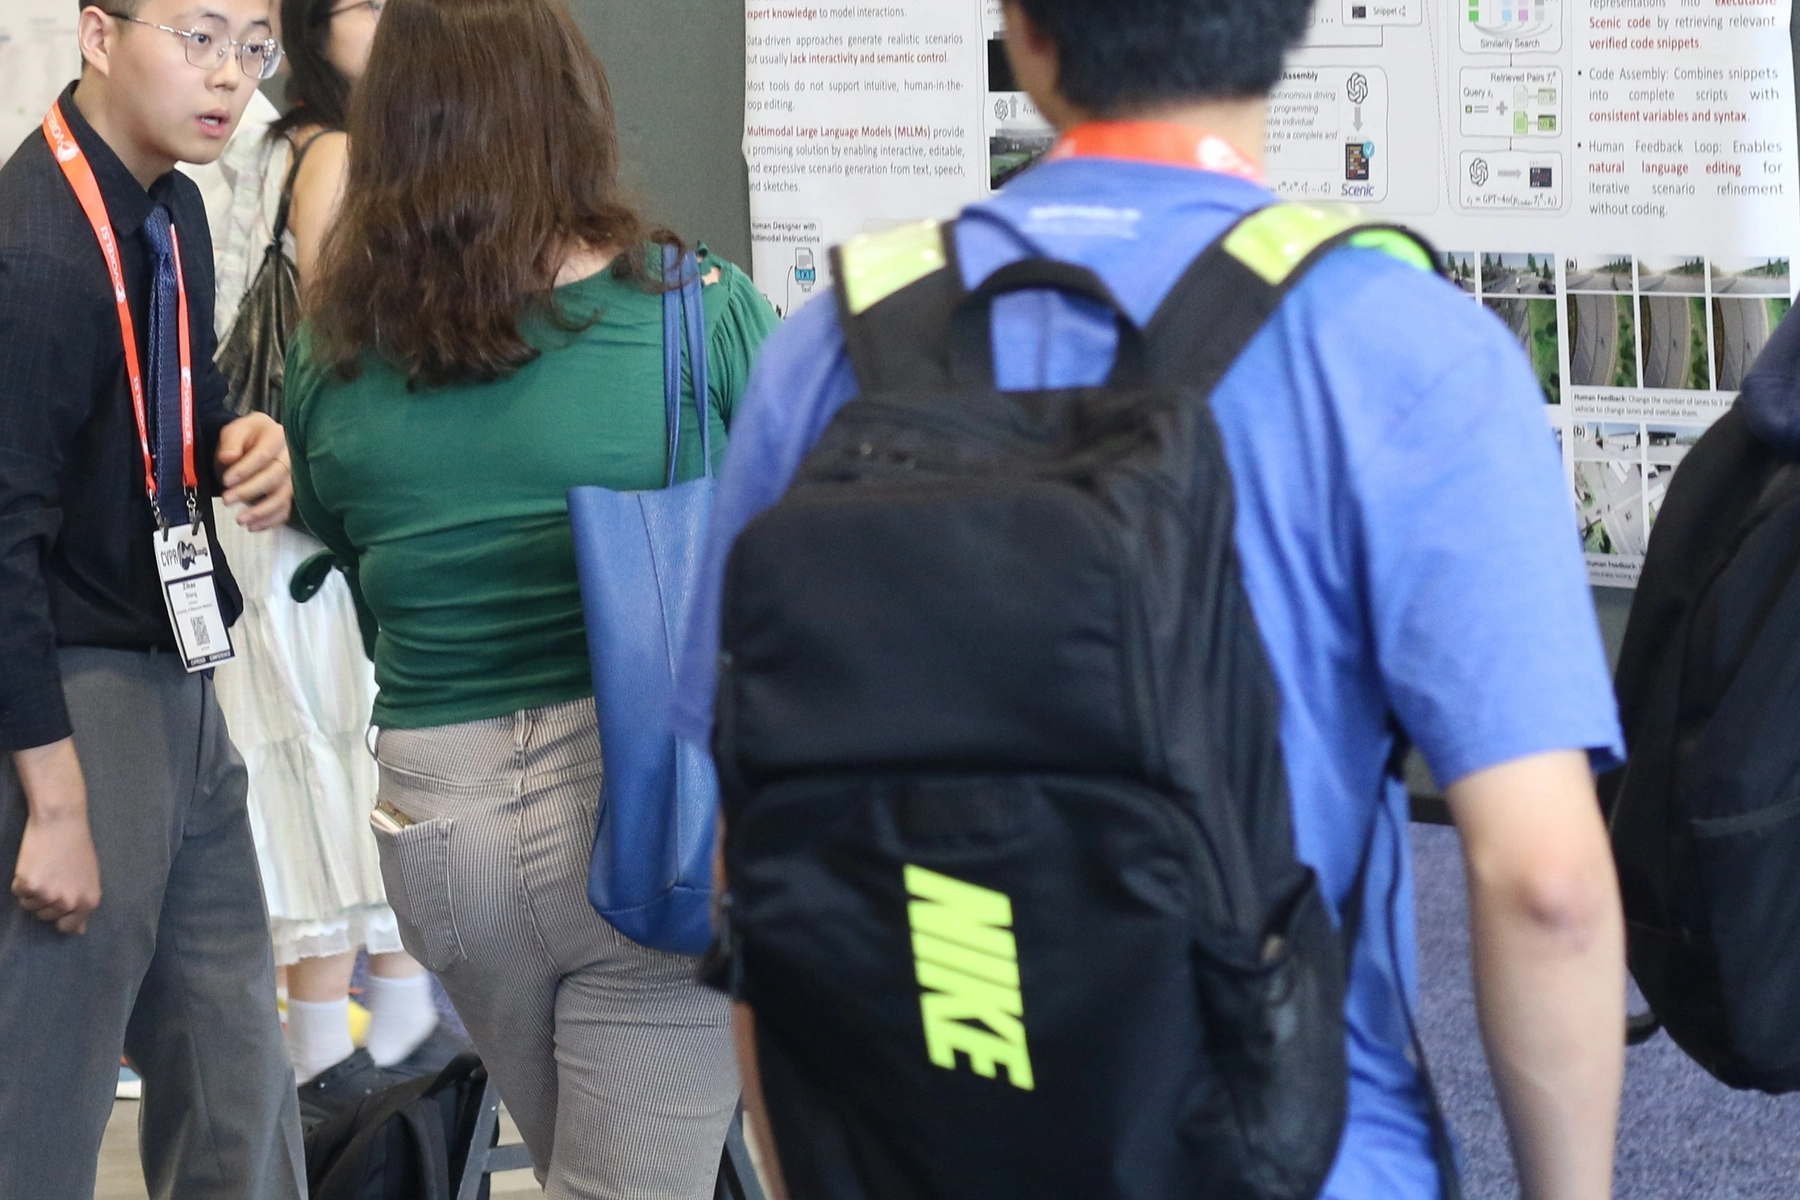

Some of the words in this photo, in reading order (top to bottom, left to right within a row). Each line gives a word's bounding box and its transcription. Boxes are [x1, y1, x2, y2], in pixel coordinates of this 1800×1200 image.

[772, 4, 817, 20] knowledge
[830, 3, 855, 18] model
[1590, 17, 1620, 29] Scenic
[1628, 16, 1651, 28] code
[1658, 16, 1668, 29] by
[1675, 15, 1722, 29] retrieving
[1729, 15, 1775, 27] relevant
[796, 34, 843, 48] approaches
[848, 35, 882, 47] generate
[888, 33, 919, 44] realistic
[925, 33, 963, 44] scenarios
[1481, 39, 1512, 49] Similarity
[1515, 39, 1540, 47] Search
[1590, 37, 1627, 49] verified
[1631, 37, 1654, 49] code
[760, 53, 789, 68] usually
[790, 53, 806, 64] lack
[809, 52, 858, 65] interactivity
[860, 51, 875, 62] and
[877, 51, 914, 62] semantic
[1282, 72, 1318, 81] Assembly
[1491, 73, 1525, 82] Retrieved
[1527, 73, 1545, 82] Pairs
[1590, 67, 1614, 80] Code
[1620, 67, 1668, 82] Assembly:
[1674, 67, 1723, 80] Combines
[1729, 68, 1778, 82] snippets
[770, 80, 789, 91] tools
[795, 80, 805, 90] do
[810, 81, 824, 90] not
[829, 80, 859, 93] support
[1464, 88, 1485, 98] Query
[1590, 89, 1608, 101] into
[1629, 88, 1674, 103] complete
[1696, 88, 1727, 103] scripts
[1750, 88, 1779, 100] with
[1590, 109, 1640, 122] consistent
[1643, 109, 1688, 122] variables
[1692, 109, 1711, 121] and
[796, 126, 817, 139] Large
[821, 126, 858, 139] Language
[862, 125, 891, 136] Models
[934, 125, 964, 139] provide
[753, 145, 793, 157] promising
[796, 144, 829, 155] solution
[844, 143, 877, 157] enabling
[1590, 140, 1624, 153] Human
[1636, 140, 1683, 152] Feedback
[1695, 141, 1721, 154] Loop:
[1733, 140, 1782, 153] Enables
[763, 163, 806, 177] expressive
[809, 163, 842, 174] scenario
[845, 163, 887, 176] generation
[890, 162, 910, 174] from
[1589, 161, 1624, 173] natural
[1642, 161, 1688, 176] language
[1706, 161, 1741, 176] editing
[1589, 183, 1629, 194] iterative
[1652, 183, 1695, 194] scenario
[1717, 182, 1783, 195] refinement
[1590, 203, 1628, 215] without
[100, 224, 120, 281] VOXEL51
[1565, 256, 1578, 272] (a)
[1628, 396, 1650, 405] Change
[1662, 397, 1685, 405] number
[1694, 398, 1709, 406] lanes
[1604, 407, 1625, 416] change
[1627, 407, 1641, 415] lanes
[1655, 408, 1680, 416] overtake
[161, 550, 179, 567] CVPR
[903, 863, 1035, 1091] NIKE
